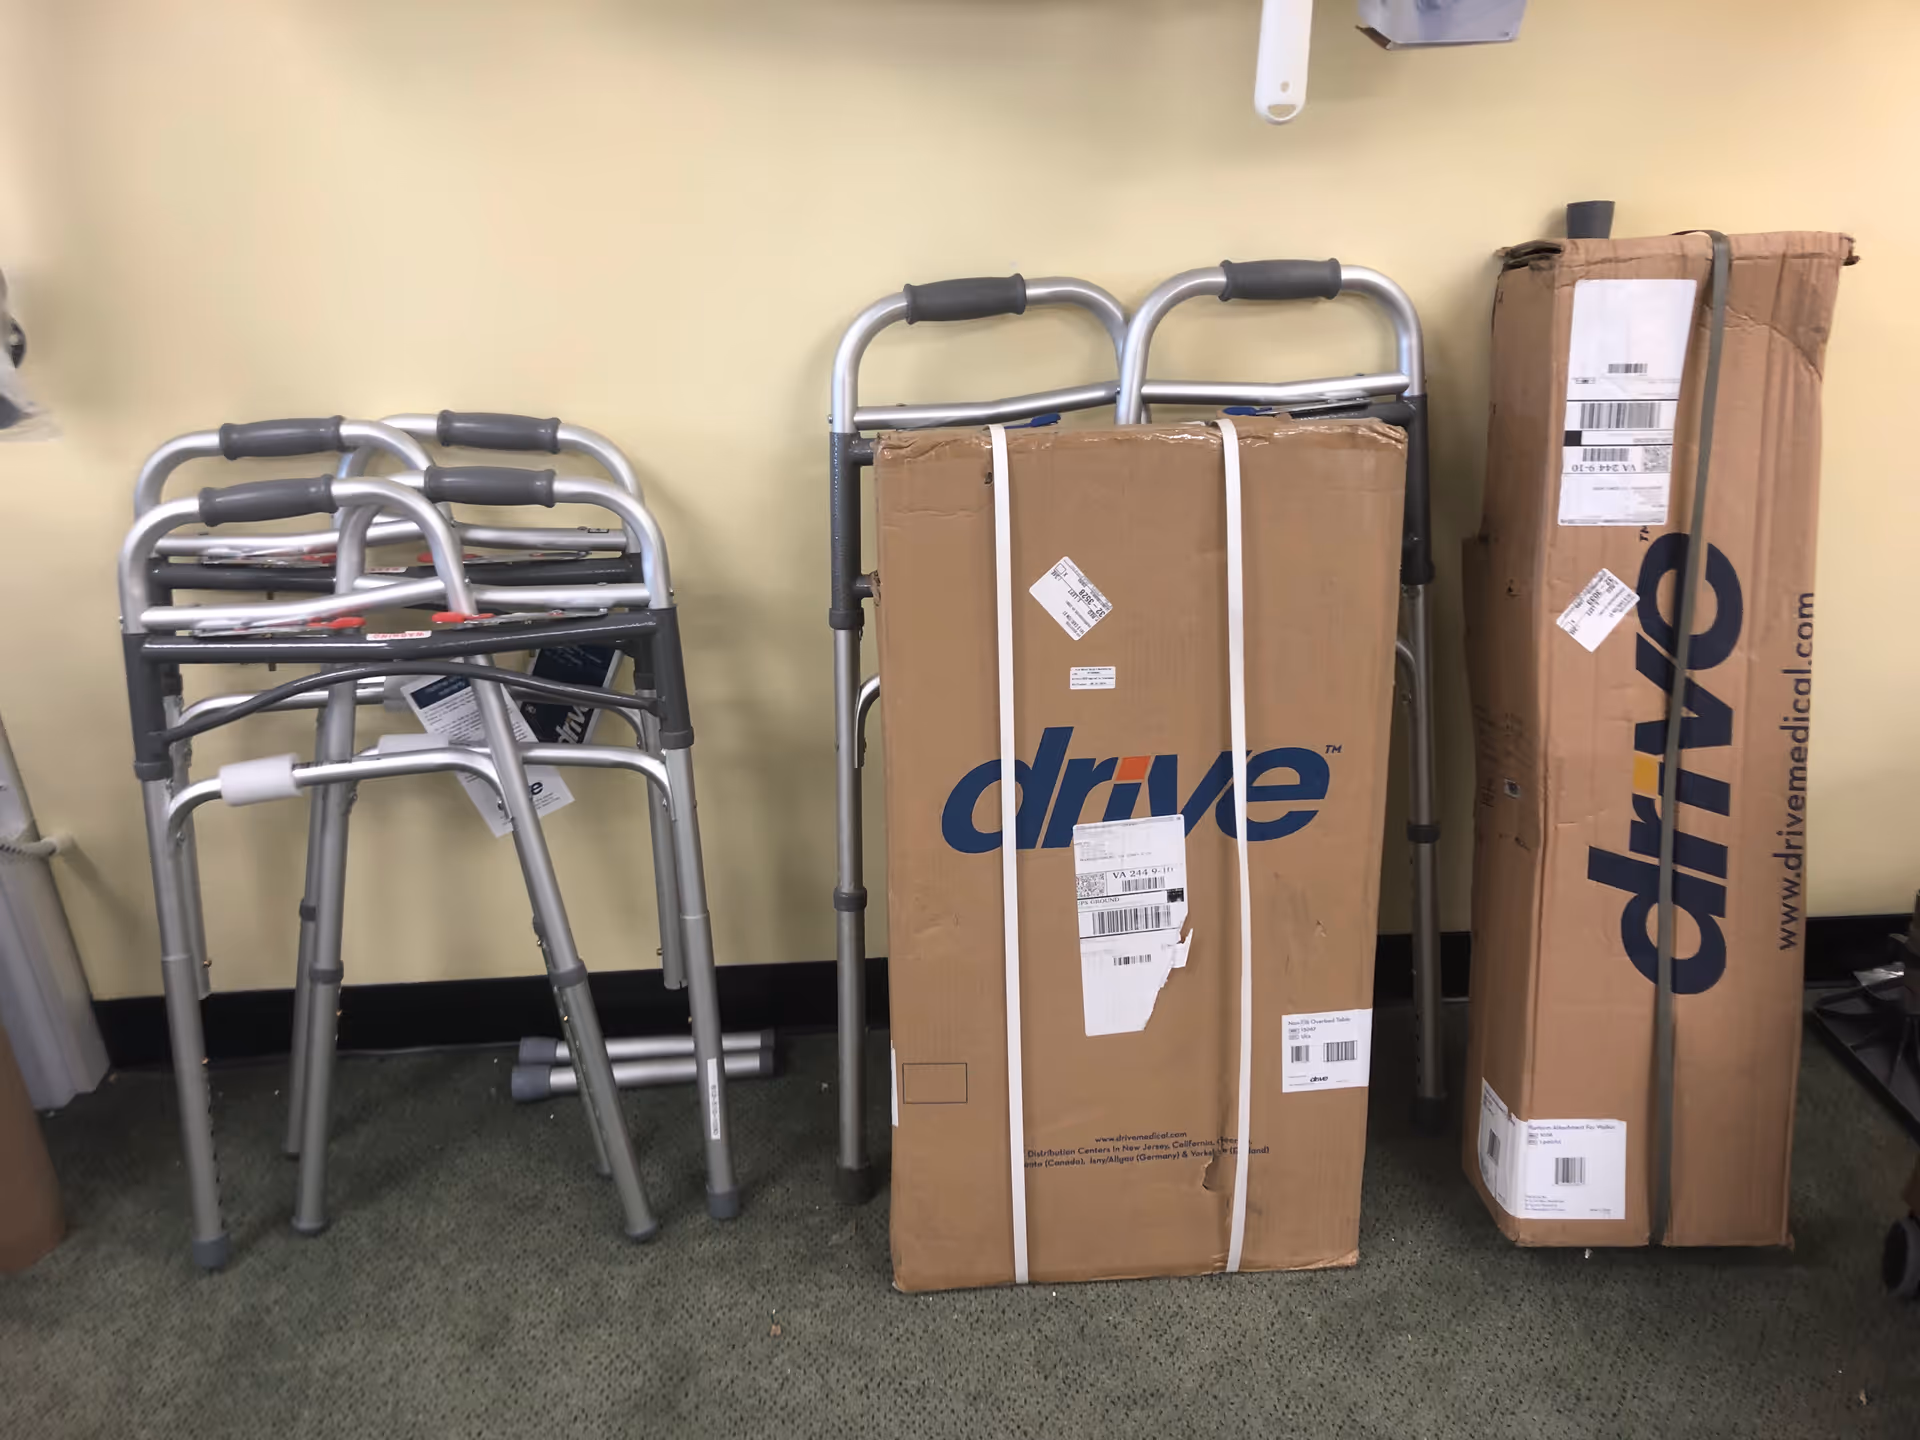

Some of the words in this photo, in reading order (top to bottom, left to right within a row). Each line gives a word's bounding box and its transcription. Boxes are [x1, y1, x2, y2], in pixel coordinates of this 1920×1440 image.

[1622, 464, 1636, 472] VA
[1068, 588, 1079, 600] LEFT
[556, 705, 588, 744] driv
[1588, 533, 1743, 995] drive
[1772, 592, 1814, 951] www.drivemedical.com
[942, 726, 1330, 854] drive
[1325, 745, 1342, 755] TM
[1112, 871, 1127, 879] VA
[1129, 869, 1148, 878] 244
[1095, 1131, 1187, 1143] www.drivemedical.com
[1028, 1148, 1076, 1158] Distribution
[1077, 1147, 1110, 1155] Centers
[1122, 1143, 1140, 1151] New
[1136, 1151, 1179, 1162] (Germany)
[1182, 1150, 1188, 1158] &
[1230, 1145, 1270, 1155] (Eland)
